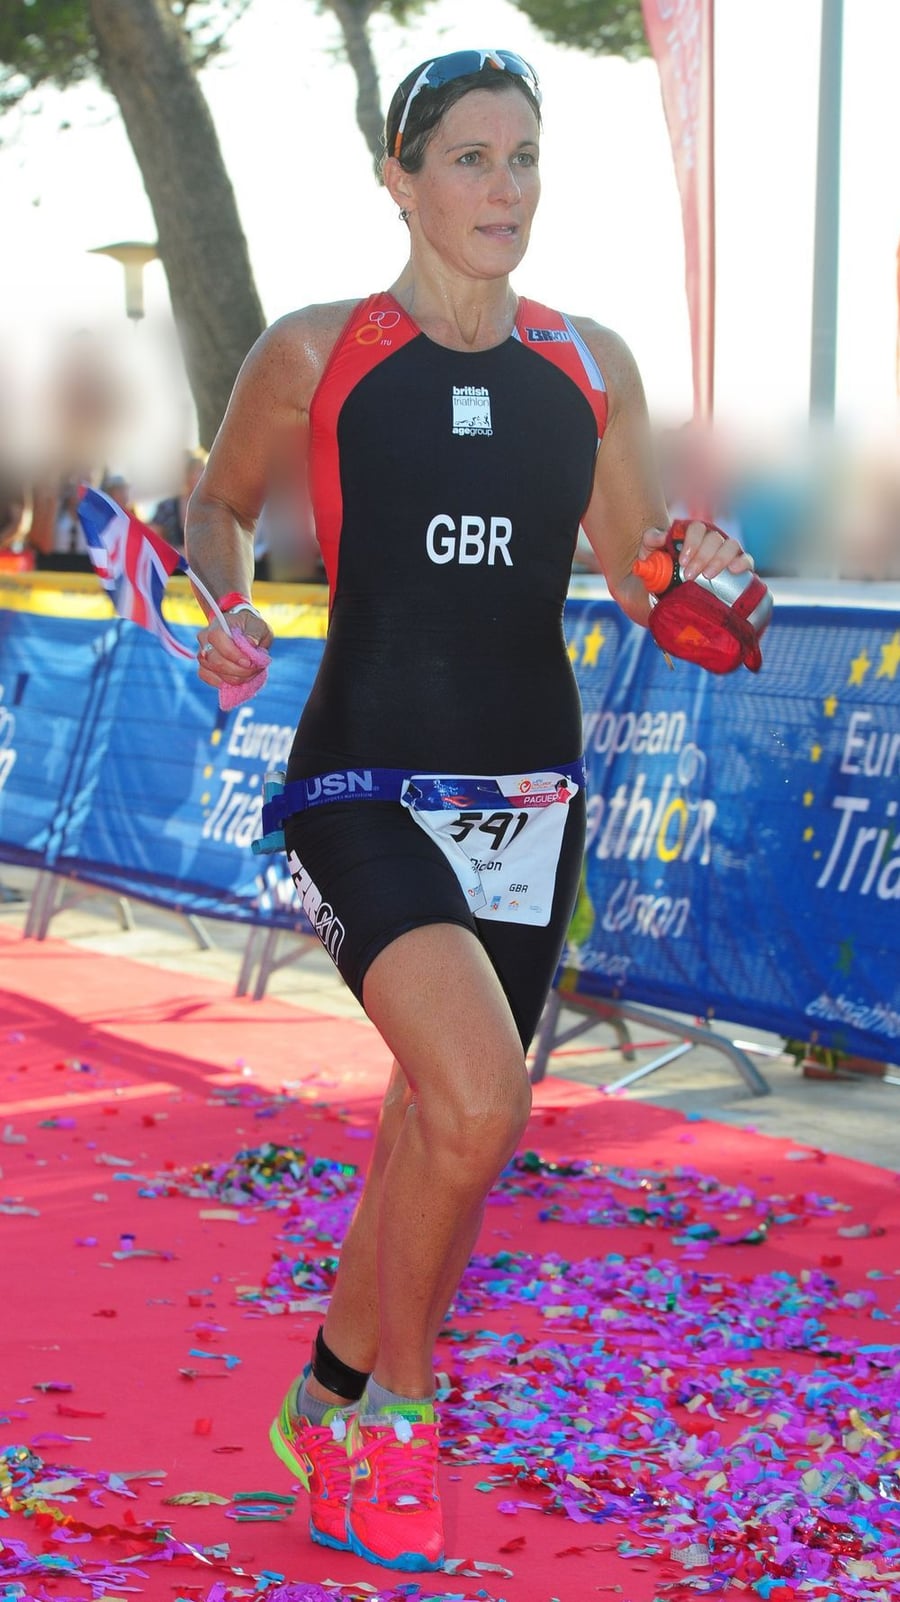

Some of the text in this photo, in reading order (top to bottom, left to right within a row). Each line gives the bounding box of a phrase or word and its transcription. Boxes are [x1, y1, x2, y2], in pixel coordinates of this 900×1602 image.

[452, 385, 489, 396] british
[453, 397, 490, 407] triathlon
[452, 428, 493, 437] agegroup
[425, 513, 514, 566] GBR
[227, 707, 298, 772] Europ
[306, 769, 373, 801] USN
[450, 811, 529, 851] 591
[508, 883, 529, 894] GBR
[602, 879, 691, 939] Union
